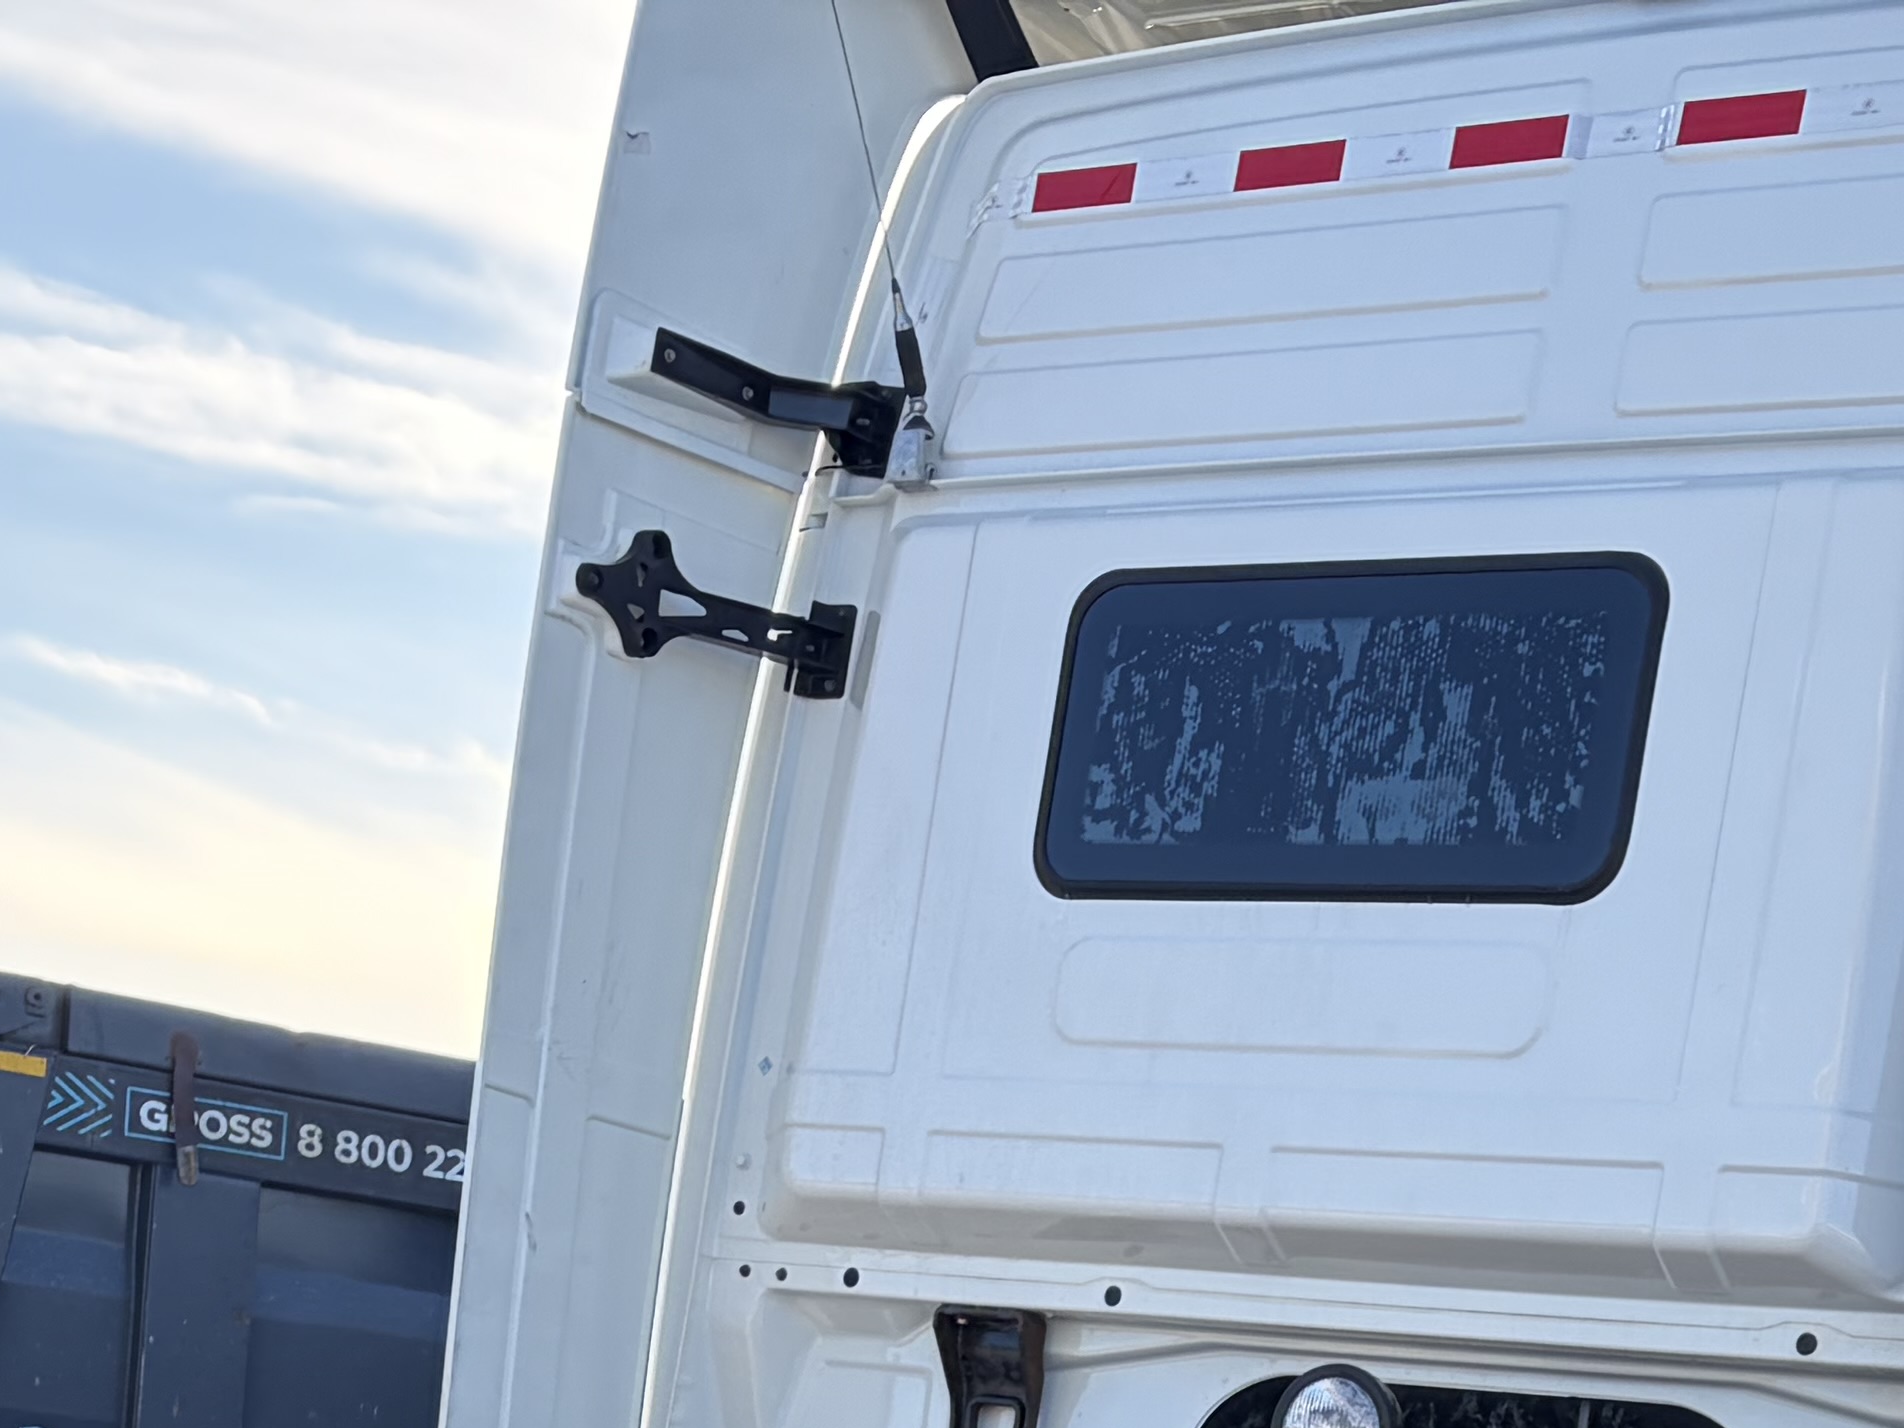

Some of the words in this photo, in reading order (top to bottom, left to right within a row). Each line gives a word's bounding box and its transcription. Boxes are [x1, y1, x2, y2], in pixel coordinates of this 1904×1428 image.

[139, 1099, 273, 1149] GOSS
[297, 1123, 323, 1159] 8
[334, 1129, 413, 1173] 800
